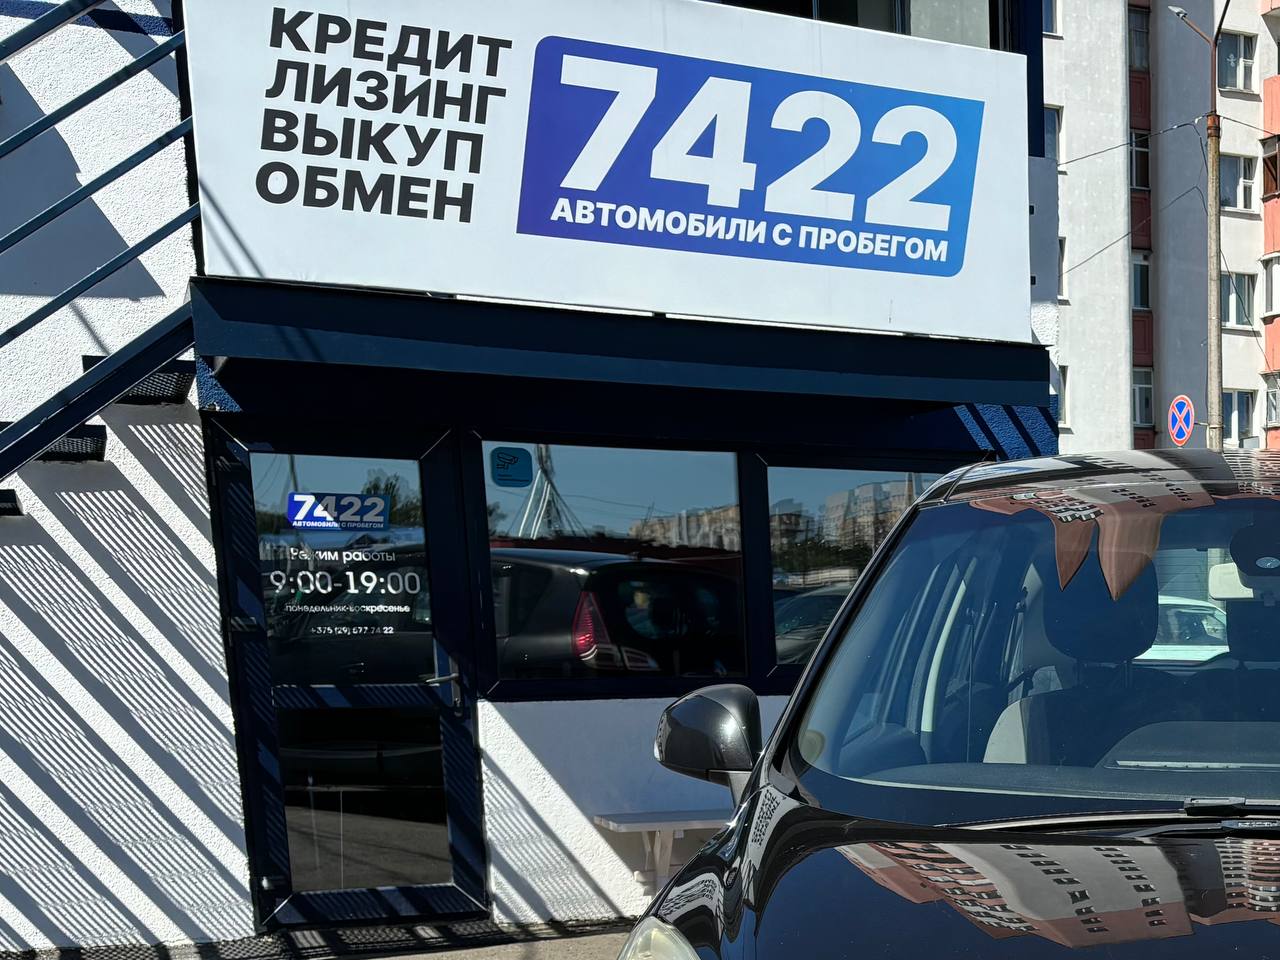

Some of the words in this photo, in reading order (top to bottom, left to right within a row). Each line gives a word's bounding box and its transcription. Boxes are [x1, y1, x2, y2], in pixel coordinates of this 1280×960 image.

[269, 7, 513, 77] КРЕДИТ
[265, 59, 507, 125] ЛИЗИНГ
[260, 108, 484, 174] ВЫКУП
[559, 54, 958, 232] 7422
[255, 161, 475, 223] ОБМЕН
[550, 197, 768, 245] АВТОМОБИЛИ
[772, 223, 793, 247] С
[798, 225, 949, 262] ПРОБЕГОМ
[293, 494, 385, 522] 7422
[342, 549, 396, 564] работы
[382, 626, 394, 634] 22
